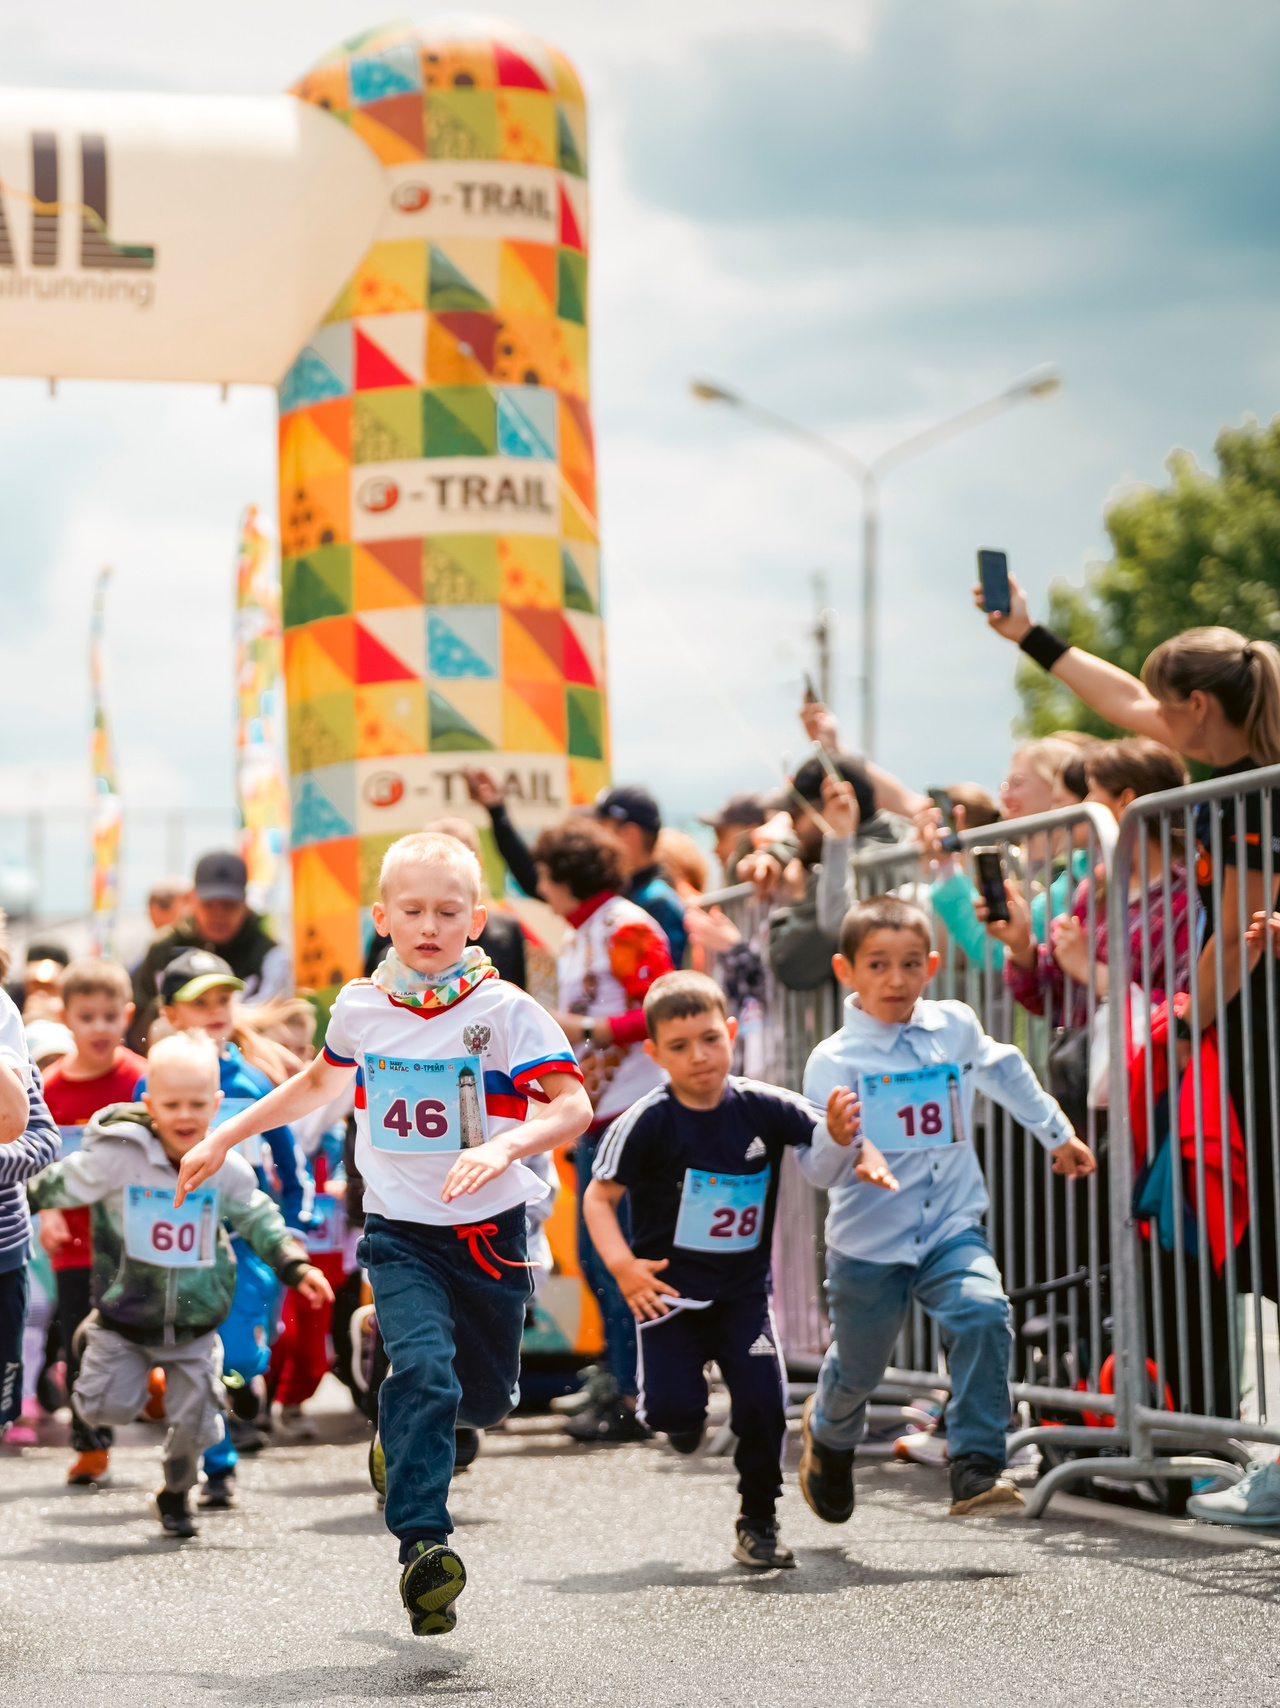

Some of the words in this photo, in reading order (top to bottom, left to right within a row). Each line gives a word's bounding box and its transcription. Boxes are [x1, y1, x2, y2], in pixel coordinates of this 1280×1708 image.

[383, 1098, 449, 1138] 46
[896, 1101, 943, 1137] 18
[151, 1220, 195, 1253] 60
[708, 1204, 759, 1238] 28
[0, 1361, 21, 1411] ONLY
